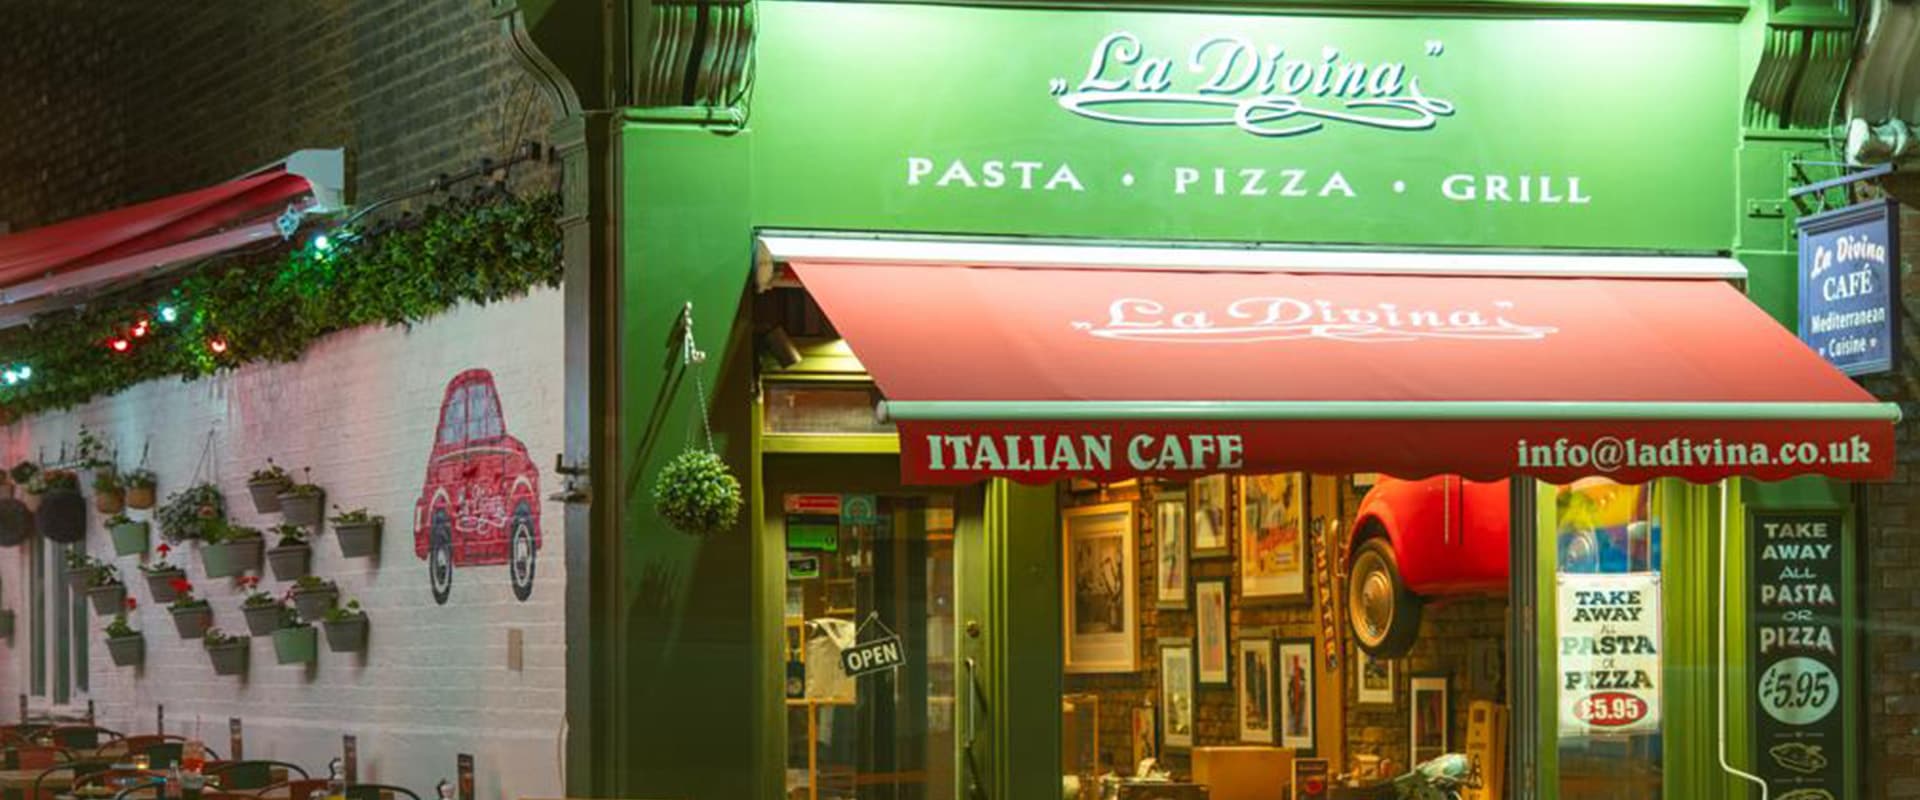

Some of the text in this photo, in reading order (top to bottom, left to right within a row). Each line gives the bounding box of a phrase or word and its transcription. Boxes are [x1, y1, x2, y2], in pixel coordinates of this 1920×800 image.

[907, 157, 1592, 203] PASTA PIZZA GRILL
[1810, 234, 1885, 279] La Divina
[1823, 262, 1873, 301] CAFÉ
[1811, 307, 1885, 334] Mediterranean
[1828, 335, 1866, 357] Cuisine
[926, 434, 1244, 471] ITALIAN CAFE
[1517, 435, 1872, 472] info@ladivina.co.uk
[1764, 523, 1828, 538] TAKE
[1762, 544, 1832, 560] AWAY
[1779, 566, 1817, 580] ALL
[1316, 534, 1335, 656] THEATER
[1575, 590, 1641, 606] TAKE
[1761, 584, 1836, 605] PASTA
[1573, 607, 1642, 622] AWAY
[1782, 609, 1813, 622] OR
[1562, 635, 1657, 655] PASTA
[1760, 625, 1836, 655] PIZZA
[847, 642, 899, 671] OPEN
[1565, 670, 1654, 690] PIZZA
[1763, 668, 1830, 708] £5.95
[1581, 698, 1639, 720] £5.95
